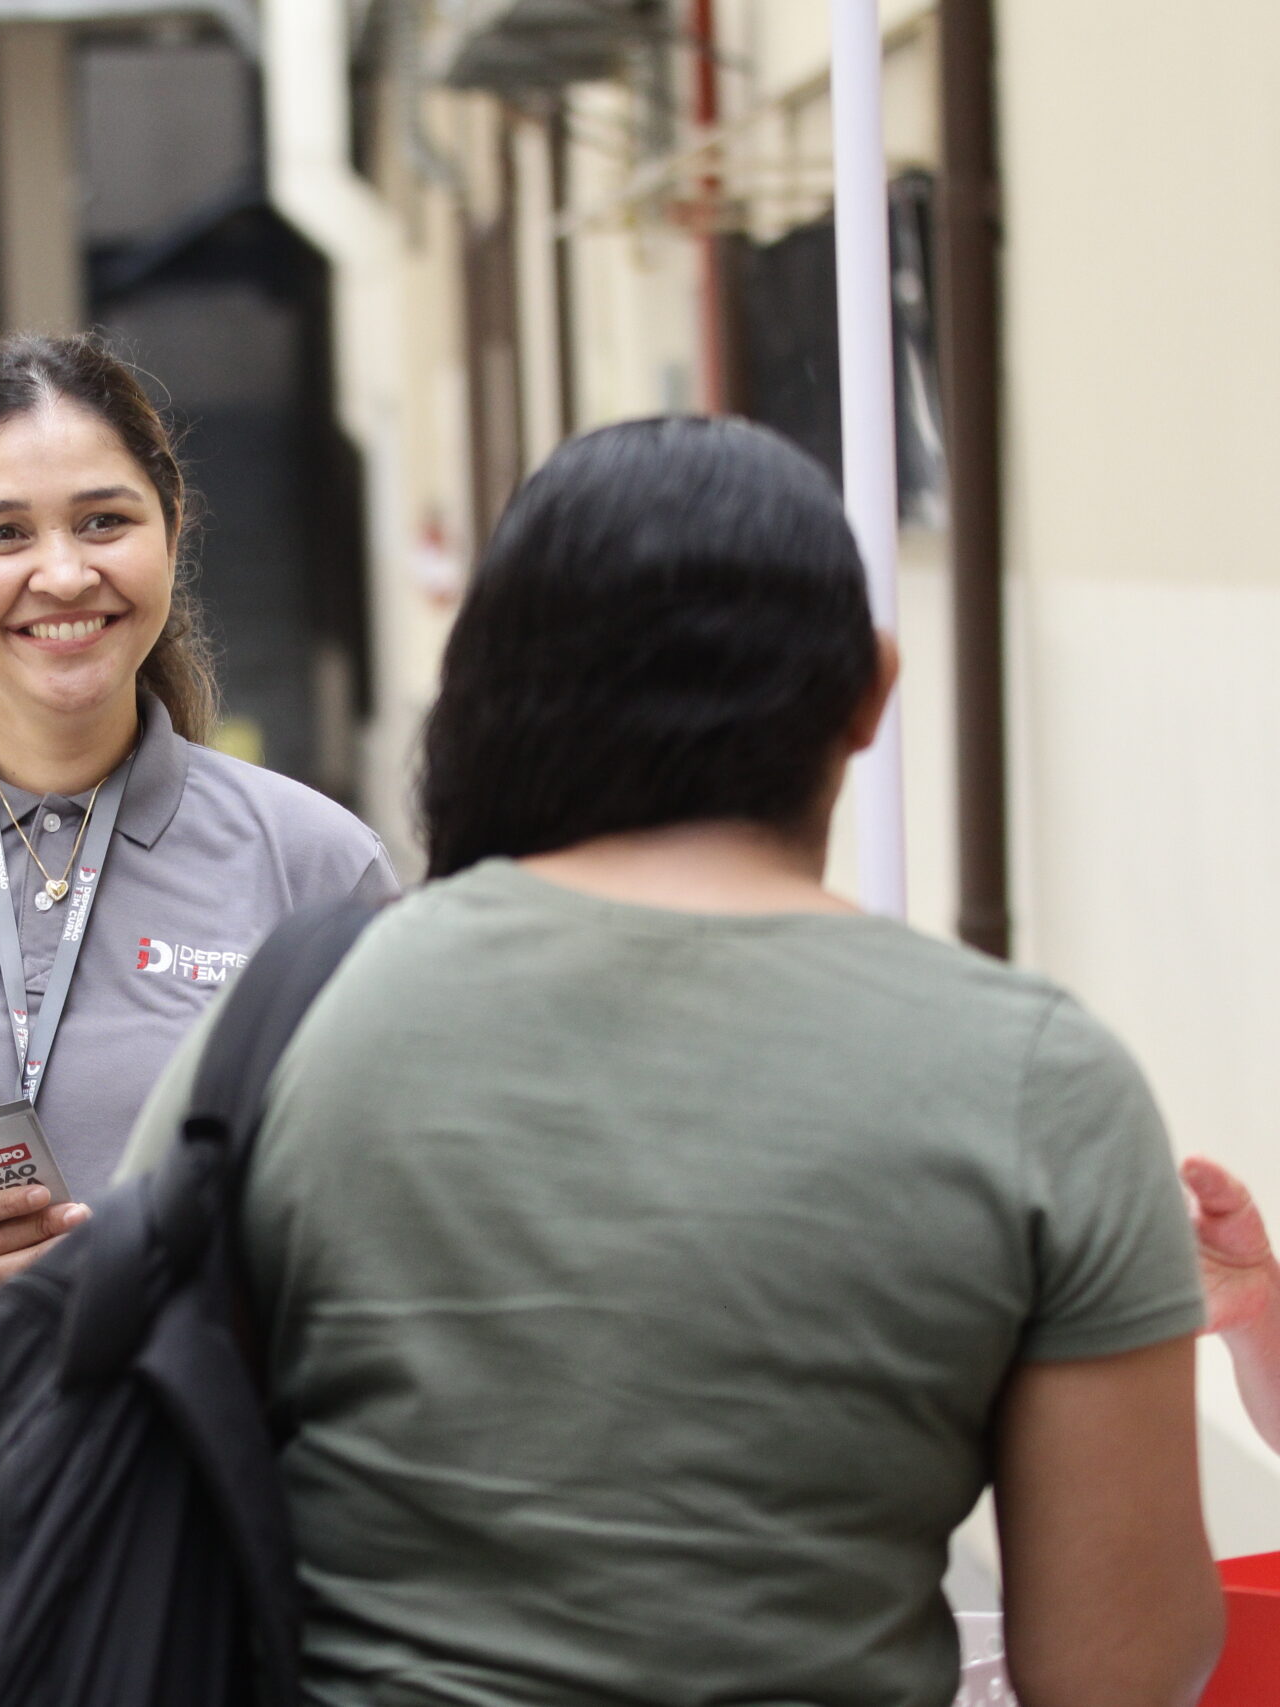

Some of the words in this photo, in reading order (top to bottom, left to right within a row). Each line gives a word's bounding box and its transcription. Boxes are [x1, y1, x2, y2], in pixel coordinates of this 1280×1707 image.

[71, 886, 83, 907] TEM
[62, 909, 78, 941] CURA!
[70, 887, 92, 942] DEPRESSÃO
[179, 945, 249, 968] DEPRE
[178, 961, 227, 981] TEM
